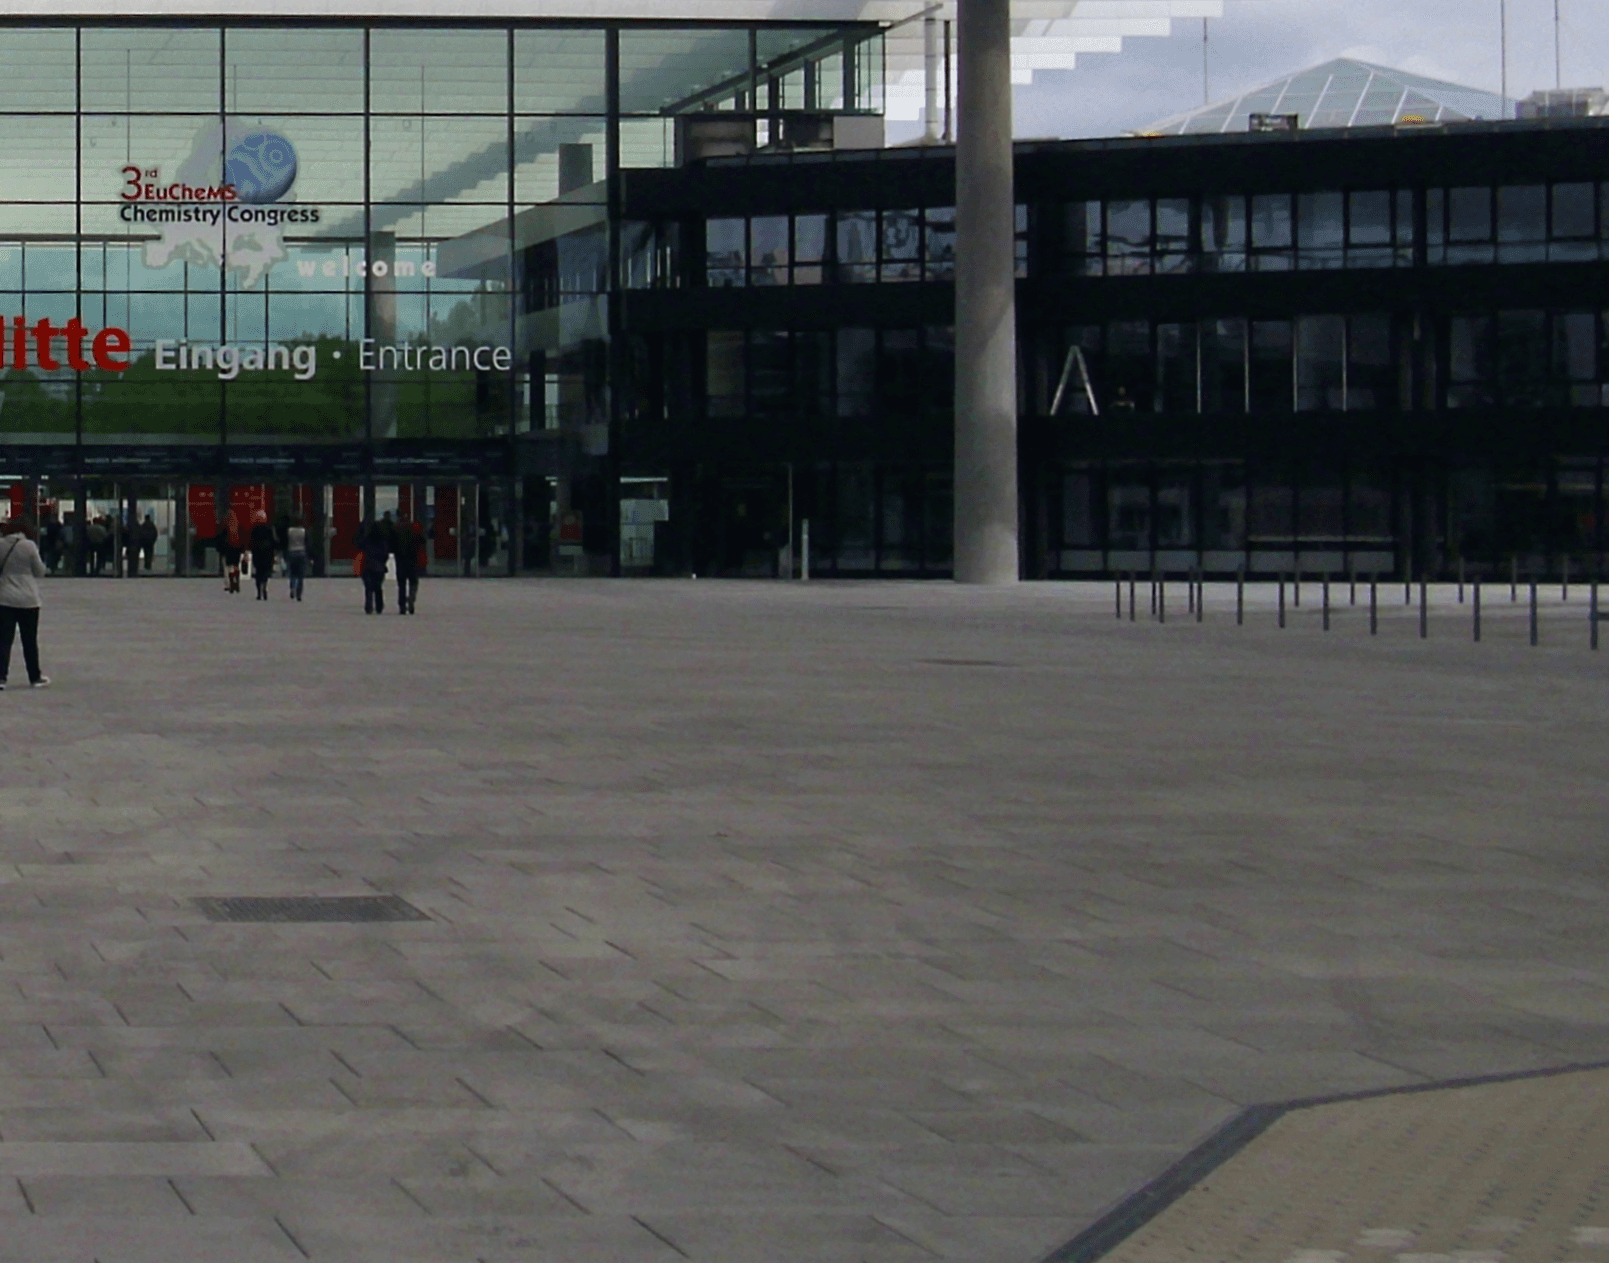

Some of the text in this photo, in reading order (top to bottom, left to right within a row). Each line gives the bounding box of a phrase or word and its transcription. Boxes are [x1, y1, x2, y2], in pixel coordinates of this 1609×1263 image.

[144, 183, 238, 201] EuCheMS
[120, 205, 320, 226] Chemistry Congress
[296, 254, 437, 278] welcome
[154, 338, 317, 380] Eingang
[358, 337, 513, 371] Entrance
